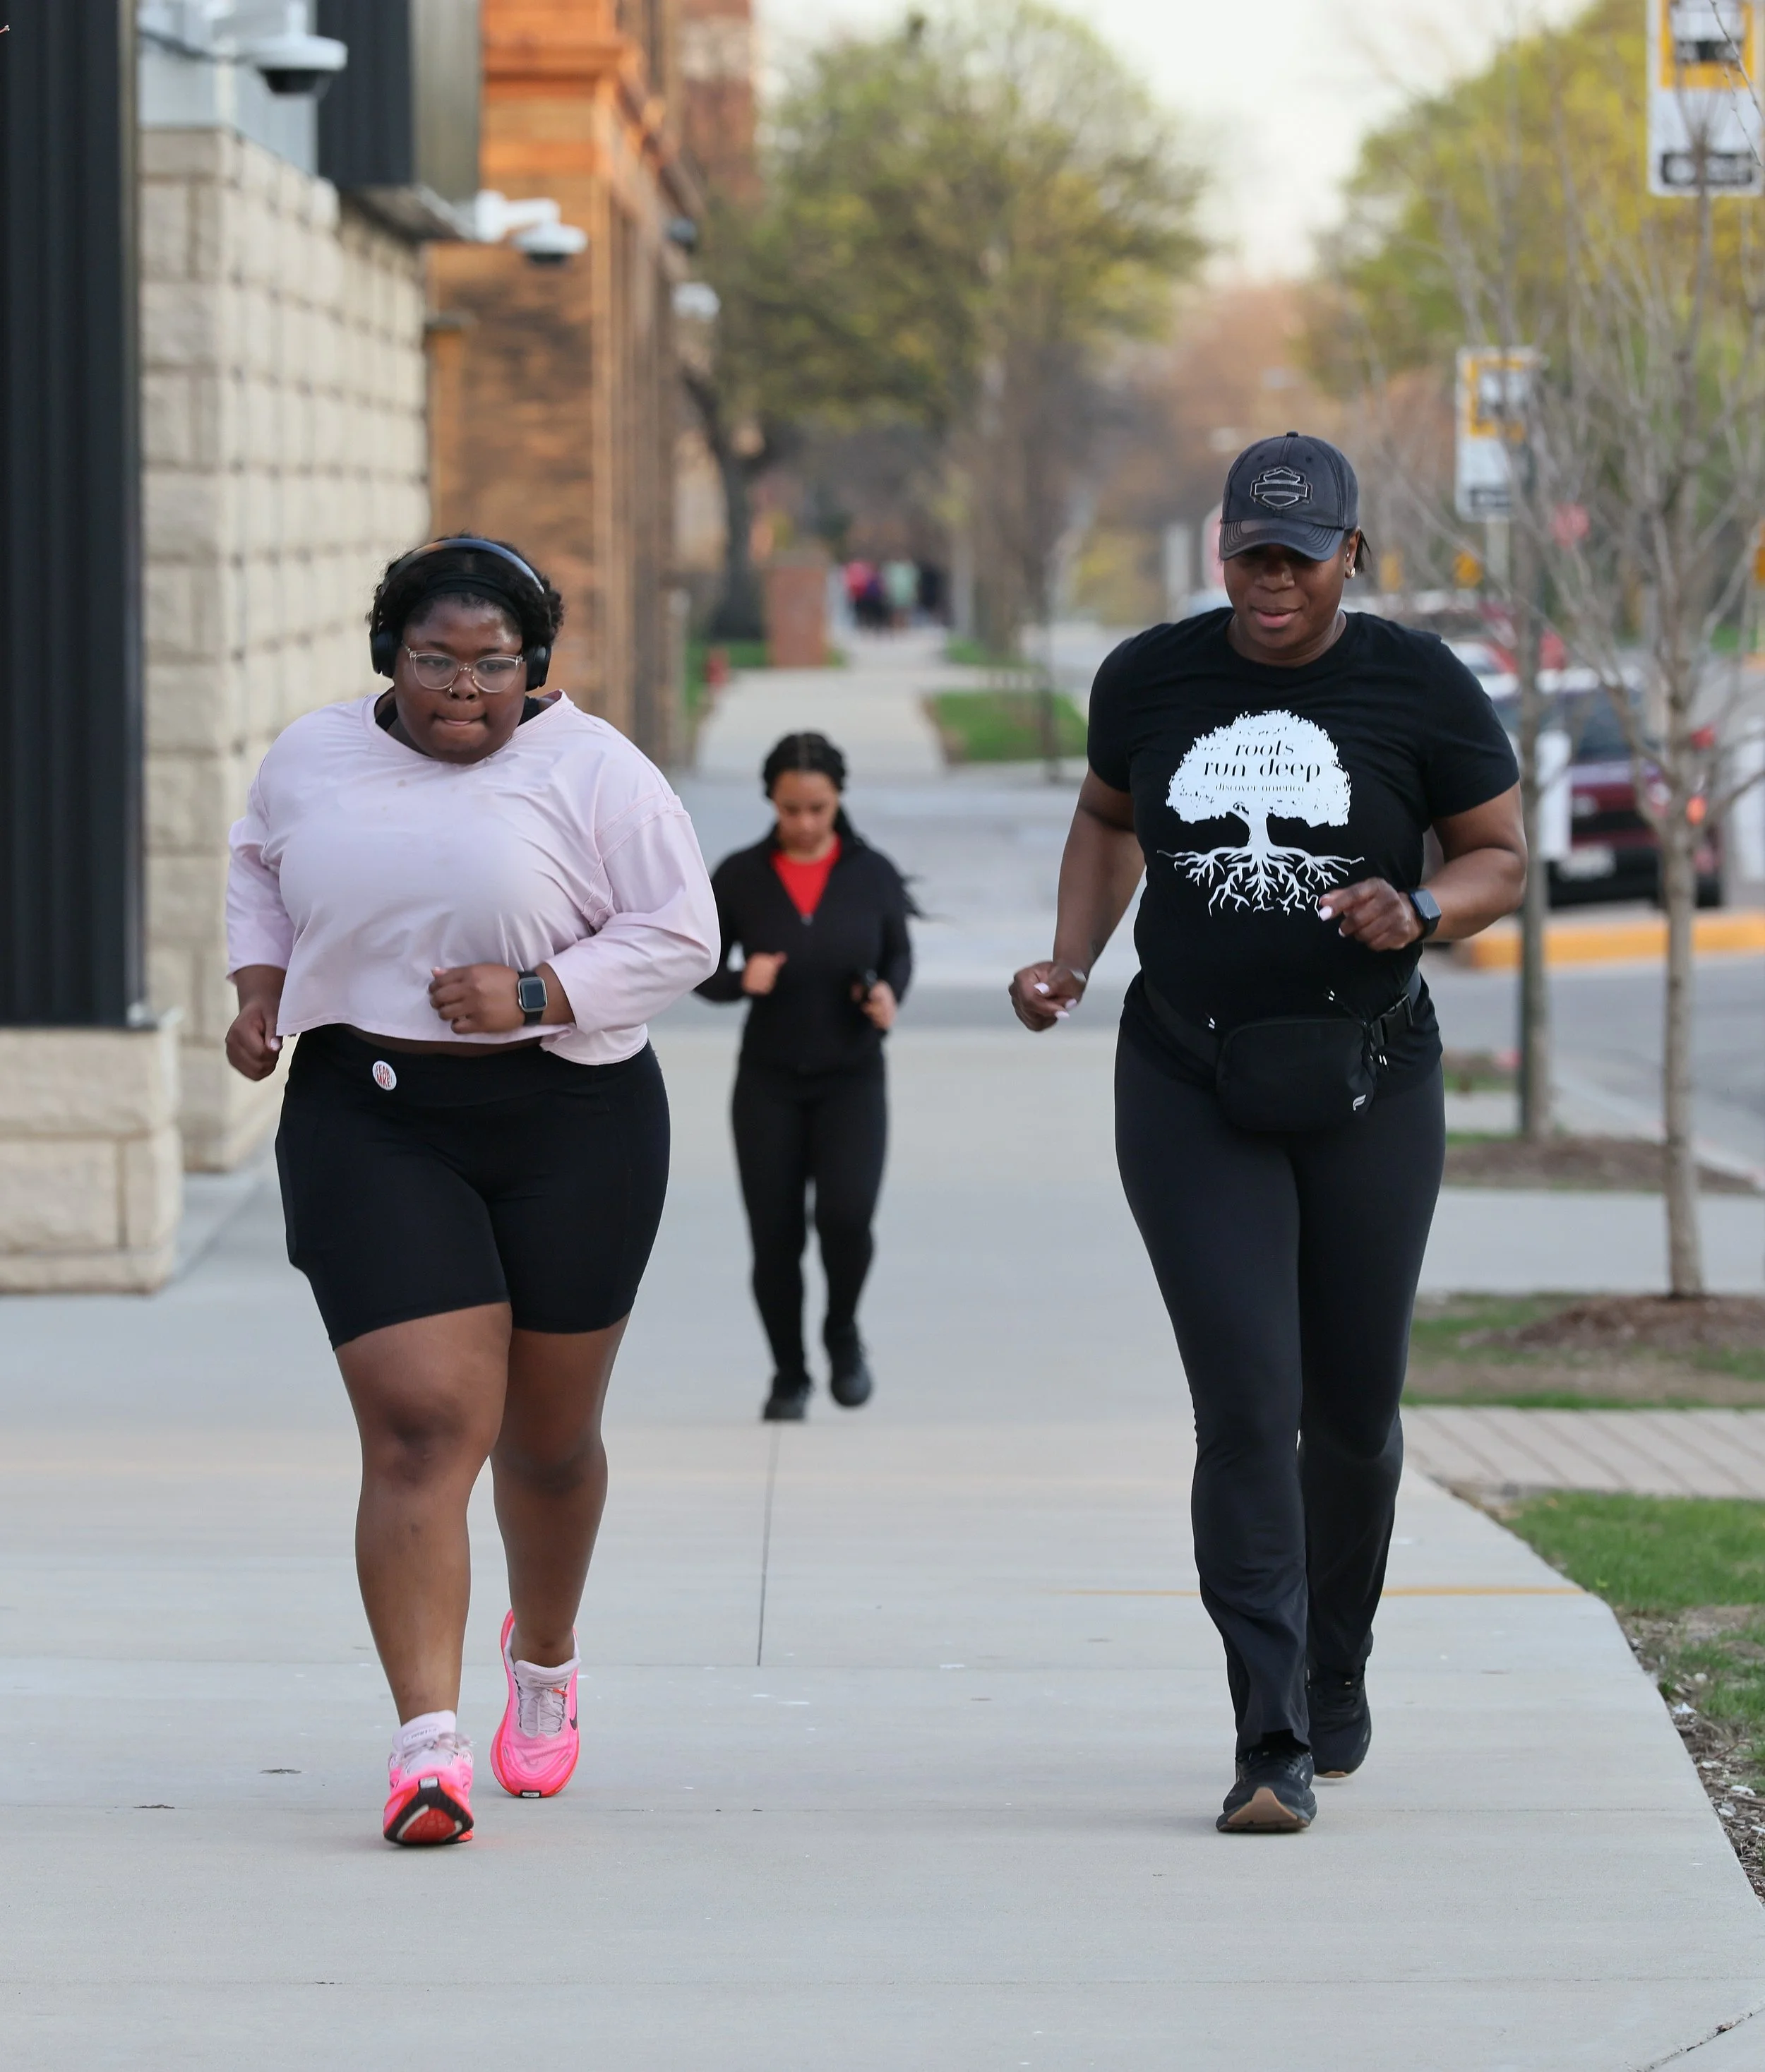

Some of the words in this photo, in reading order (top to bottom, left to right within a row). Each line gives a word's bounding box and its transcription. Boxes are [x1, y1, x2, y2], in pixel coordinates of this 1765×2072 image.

[1236, 740, 1294, 756] roots
[1204, 762, 1246, 777] run
[1260, 758, 1320, 782] deep
[1215, 783, 1257, 791] discover
[1262, 784, 1304, 792] america
